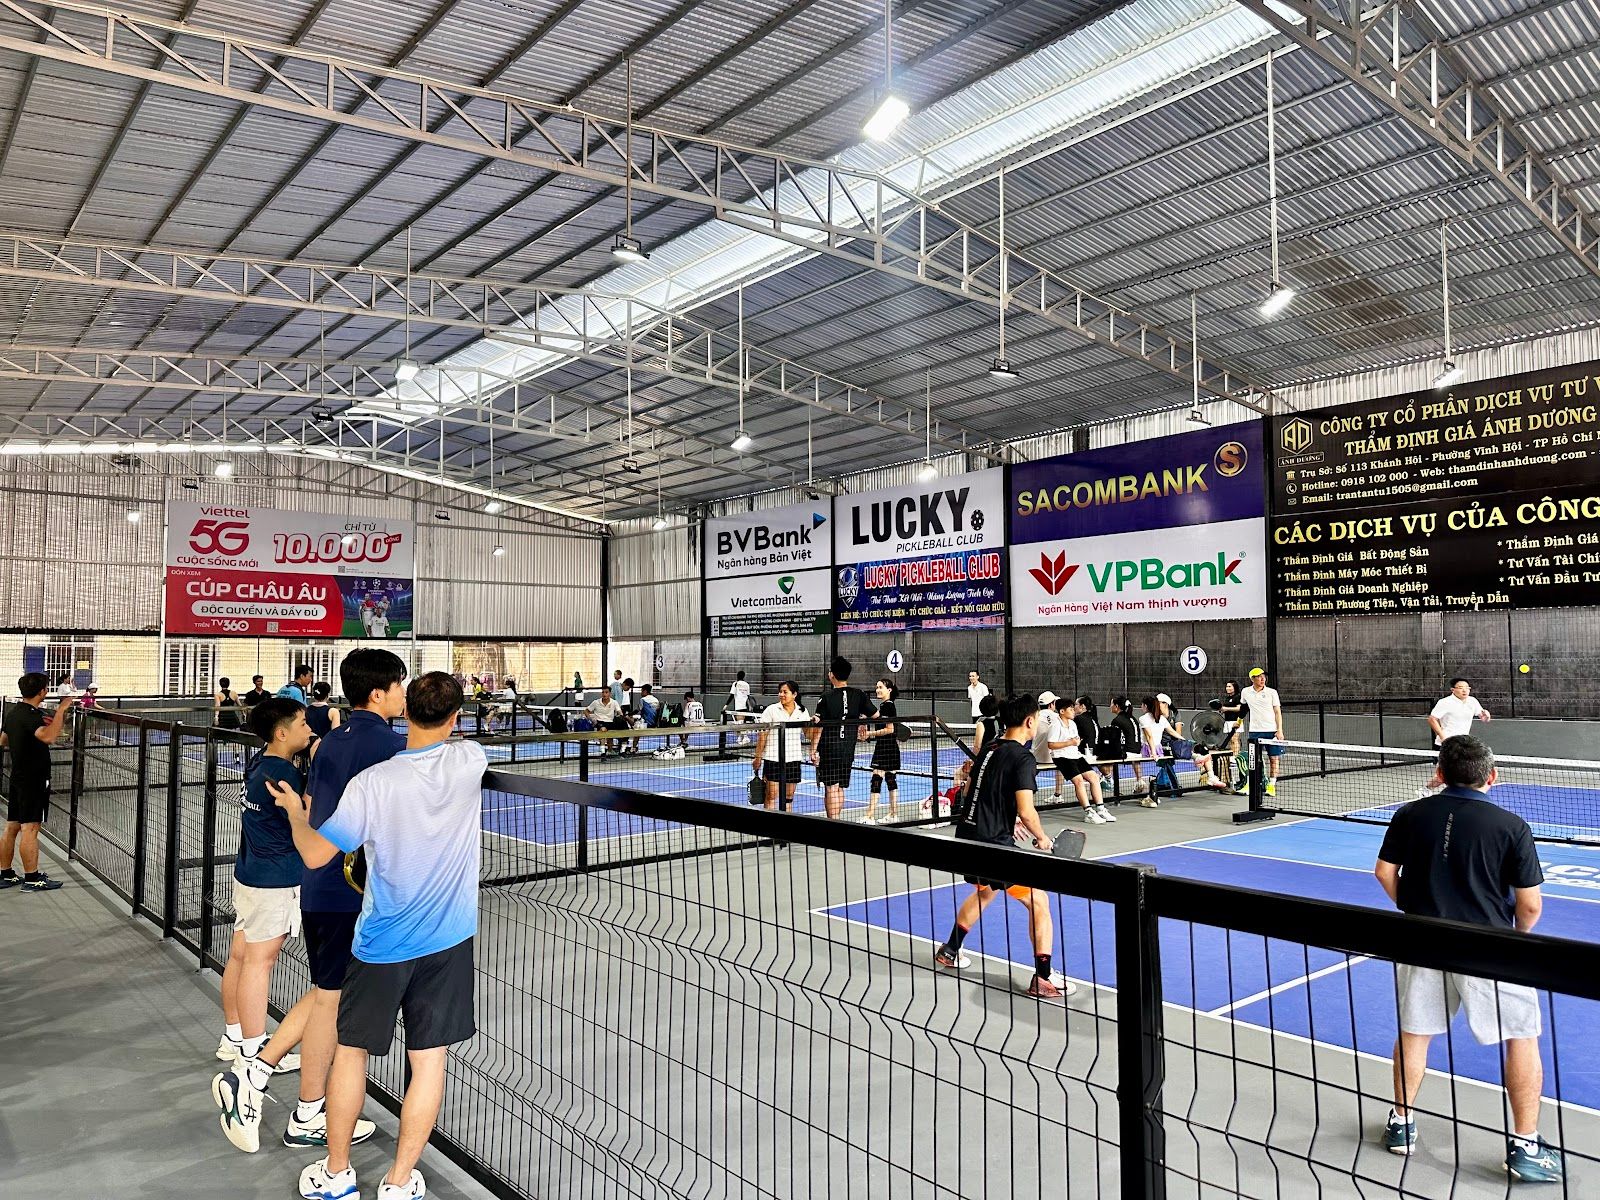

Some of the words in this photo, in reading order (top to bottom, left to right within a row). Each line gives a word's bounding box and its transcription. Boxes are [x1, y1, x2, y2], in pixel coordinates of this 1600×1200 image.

[1320, 416, 1363, 435] CÔNG
[1368, 412, 1388, 428] TY
[1394, 398, 1416, 424] CỔ
[1421, 393, 1469, 420] PHẦN
[1475, 390, 1522, 413] DỊCH
[1528, 385, 1553, 404] VỤ
[1561, 376, 1588, 398] TƯ
[1344, 430, 1391, 456] THẨM
[1396, 429, 1439, 451] ĐỊNH
[1444, 420, 1477, 442] GIÁ
[1482, 417, 1522, 438] ÁNH
[1528, 406, 1597, 430] DƯƠNG
[1319, 466, 1333, 476] Sở:
[1336, 463, 1347, 474] Số
[1351, 462, 1367, 472] 113
[1370, 458, 1402, 470] Khánh
[1405, 455, 1422, 465] Hội
[1432, 450, 1471, 461] Phường
[1473, 445, 1499, 456] Vĩnh
[1502, 441, 1522, 453] Hội
[1533, 438, 1548, 448] TP
[1552, 433, 1568, 445] Hồ
[1572, 431, 1592, 443] Chí
[1302, 480, 1338, 491] Hotline:
[1341, 476, 1365, 486] 0918
[1369, 474, 1386, 484] 102
[1389, 472, 1408, 481] 000
[1420, 468, 1445, 478] Web:
[1448, 451, 1587, 474] thamdinhanhduong.com
[1018, 463, 1208, 516] SACOMBANK
[1302, 493, 1333, 504] Email:
[1336, 477, 1478, 501] trantantu1505@gmail.com
[200, 506, 250, 518] viettel
[852, 487, 970, 545] LUCKY
[1274, 521, 1322, 544] CÁC
[1330, 517, 1393, 543] DỊCH
[1400, 513, 1437, 537] VỤ
[1448, 502, 1508, 530] CỦA
[1516, 496, 1600, 524] CÔNG
[189, 519, 250, 556] 5G
[274, 532, 392, 563] 10.000
[718, 525, 811, 555] BVBank
[896, 538, 953, 553] PICKLEBALL
[957, 533, 983, 546] CLUB
[1506, 535, 1540, 550] Thẩm
[1544, 535, 1573, 548] Định
[1577, 533, 1599, 544] Giá
[177, 555, 205, 565] CUỘC
[208, 555, 236, 567] SỐNG
[239, 559, 258, 567] MỚI
[718, 558, 741, 569] Ngân
[744, 556, 767, 566] hàng
[770, 552, 788, 563] Bản
[791, 550, 811, 561] Việt
[1283, 553, 1309, 565] Thẩm
[1312, 554, 1334, 566] Định
[1337, 552, 1353, 562] Giá
[1360, 549, 1377, 560] Bất
[1380, 549, 1406, 560] Động
[1410, 546, 1429, 557] Sản
[1507, 558, 1524, 568] Tư
[1526, 554, 1549, 567] Vấn
[1553, 554, 1574, 565] Tài
[1578, 552, 1600, 564] Chí
[864, 564, 899, 589] LUCKY
[900, 556, 967, 586] PICKLEBALL
[968, 553, 1000, 579] CLUB
[1087, 551, 1242, 593] VPBank
[1284, 569, 1310, 581] Thẩm
[1313, 570, 1335, 582] Định
[1338, 569, 1358, 580] Máy
[1361, 567, 1382, 577] Móc
[1385, 564, 1413, 576] Thiết
[1416, 564, 1427, 576] Bị
[1508, 576, 1525, 586] Tư
[1528, 573, 1550, 584] Vấn
[1554, 570, 1579, 584] Đầu
[1583, 572, 1600, 582] Tư
[186, 578, 231, 596] CÚP
[236, 581, 293, 599] CHÂU
[297, 583, 326, 600] ÂU
[840, 587, 858, 597] LUCKY
[1285, 585, 1310, 597] Thẩm
[1313, 586, 1335, 598] Định
[1339, 585, 1354, 594] Giá
[1358, 583, 1389, 594] Doanh
[1392, 582, 1428, 594] Nghiệp
[201, 604, 223, 615] ĐỘC
[265, 606, 278, 616] VÀ
[731, 594, 802, 608] Vietcombank
[909, 605, 916, 615] TỔ
[964, 602, 975, 612] NỐI
[976, 604, 990, 612] GIAO
[1038, 603, 1062, 615] Ngân
[1064, 602, 1089, 613] Hàng
[1092, 601, 1112, 612] Việt
[1116, 600, 1145, 610] Nam
[1149, 598, 1179, 610] thịnh
[1183, 597, 1227, 608] vượng
[1285, 599, 1310, 611] Thẩm
[1313, 600, 1334, 611] Định
[1337, 600, 1370, 610] Phương
[1373, 598, 1398, 609] Tiện,
[1401, 597, 1419, 608] Vận
[1423, 595, 1442, 606] Tải,
[1446, 592, 1484, 606] Truyền
[1487, 590, 1509, 603] Dẫn
[211, 619, 249, 631] TV360
[658, 656, 663, 668] 3
[891, 653, 899, 668] 4
[1188, 650, 1199, 670] 5
[695, 708, 702, 719] 10
